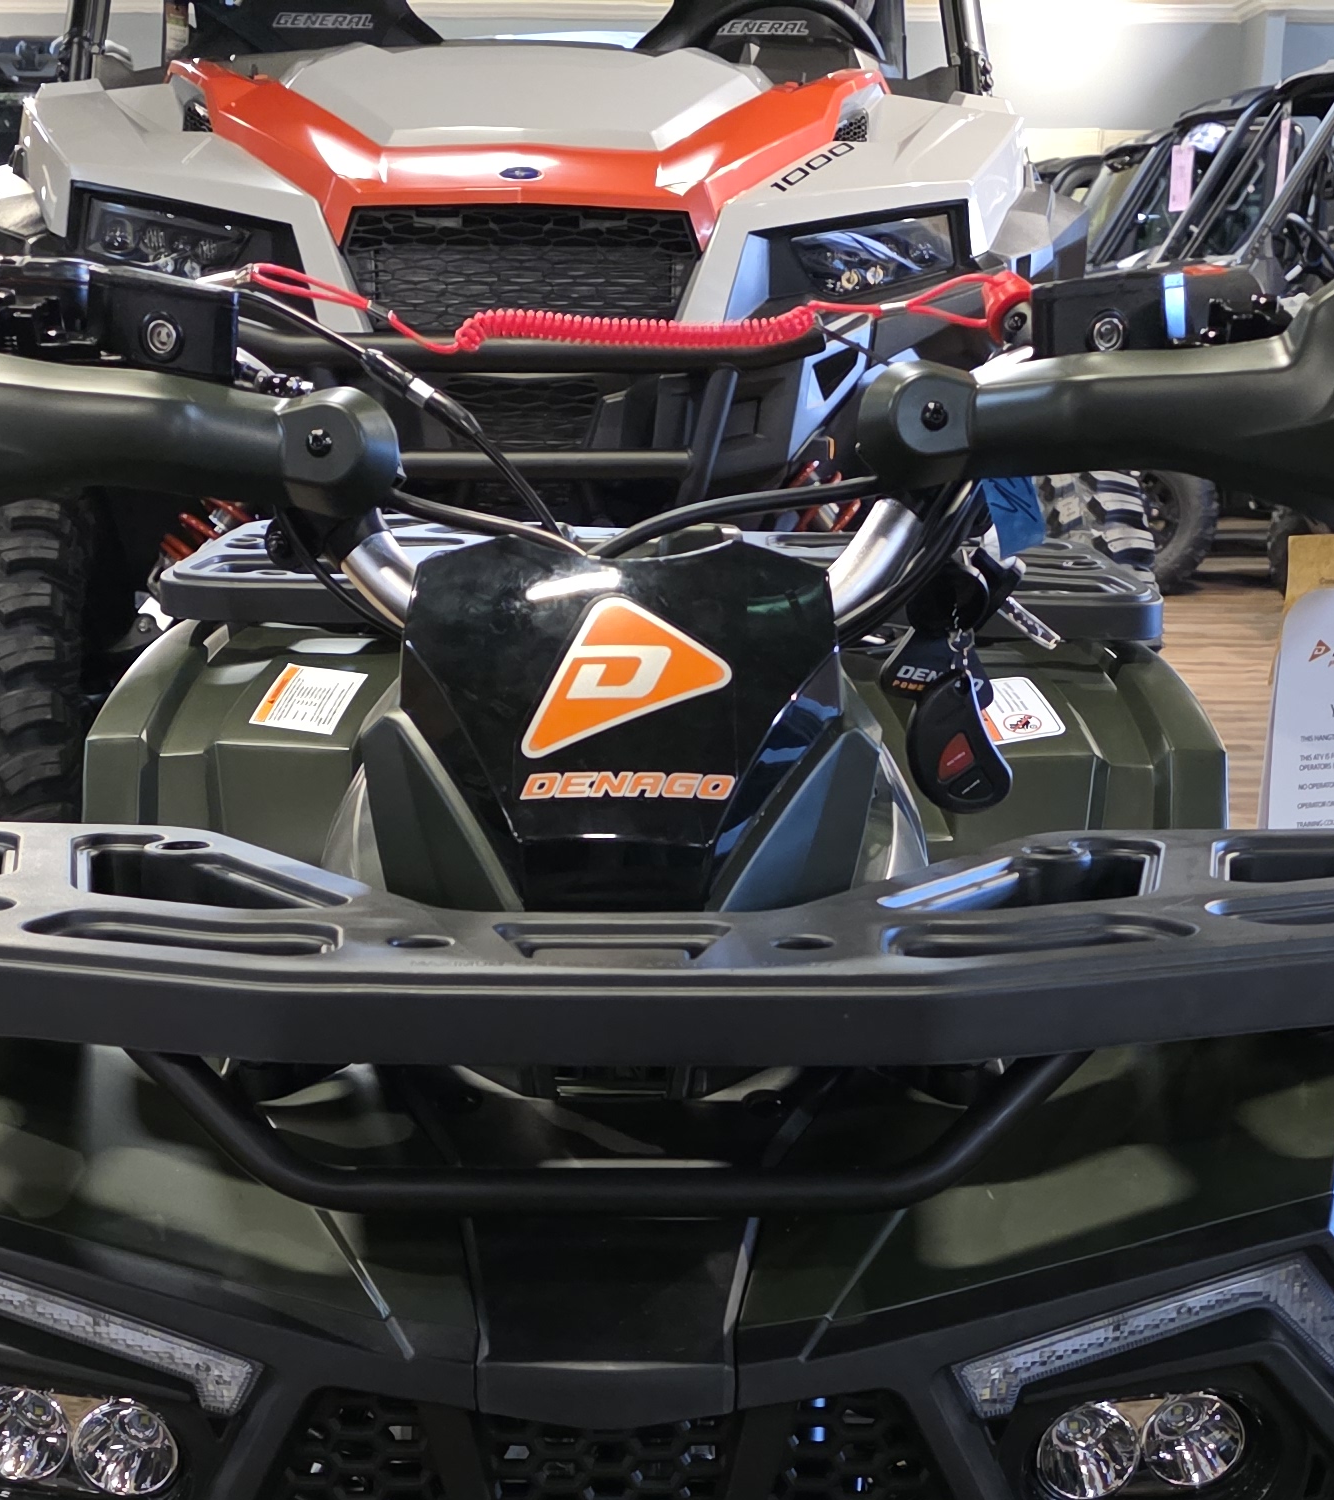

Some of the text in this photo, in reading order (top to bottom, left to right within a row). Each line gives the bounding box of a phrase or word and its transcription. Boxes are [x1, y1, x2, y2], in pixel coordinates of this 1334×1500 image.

[272, 12, 374, 29] GENERAL
[770, 142, 855, 192] 1000
[896, 665, 984, 692] DENO
[520, 771, 736, 800] DENAGO
